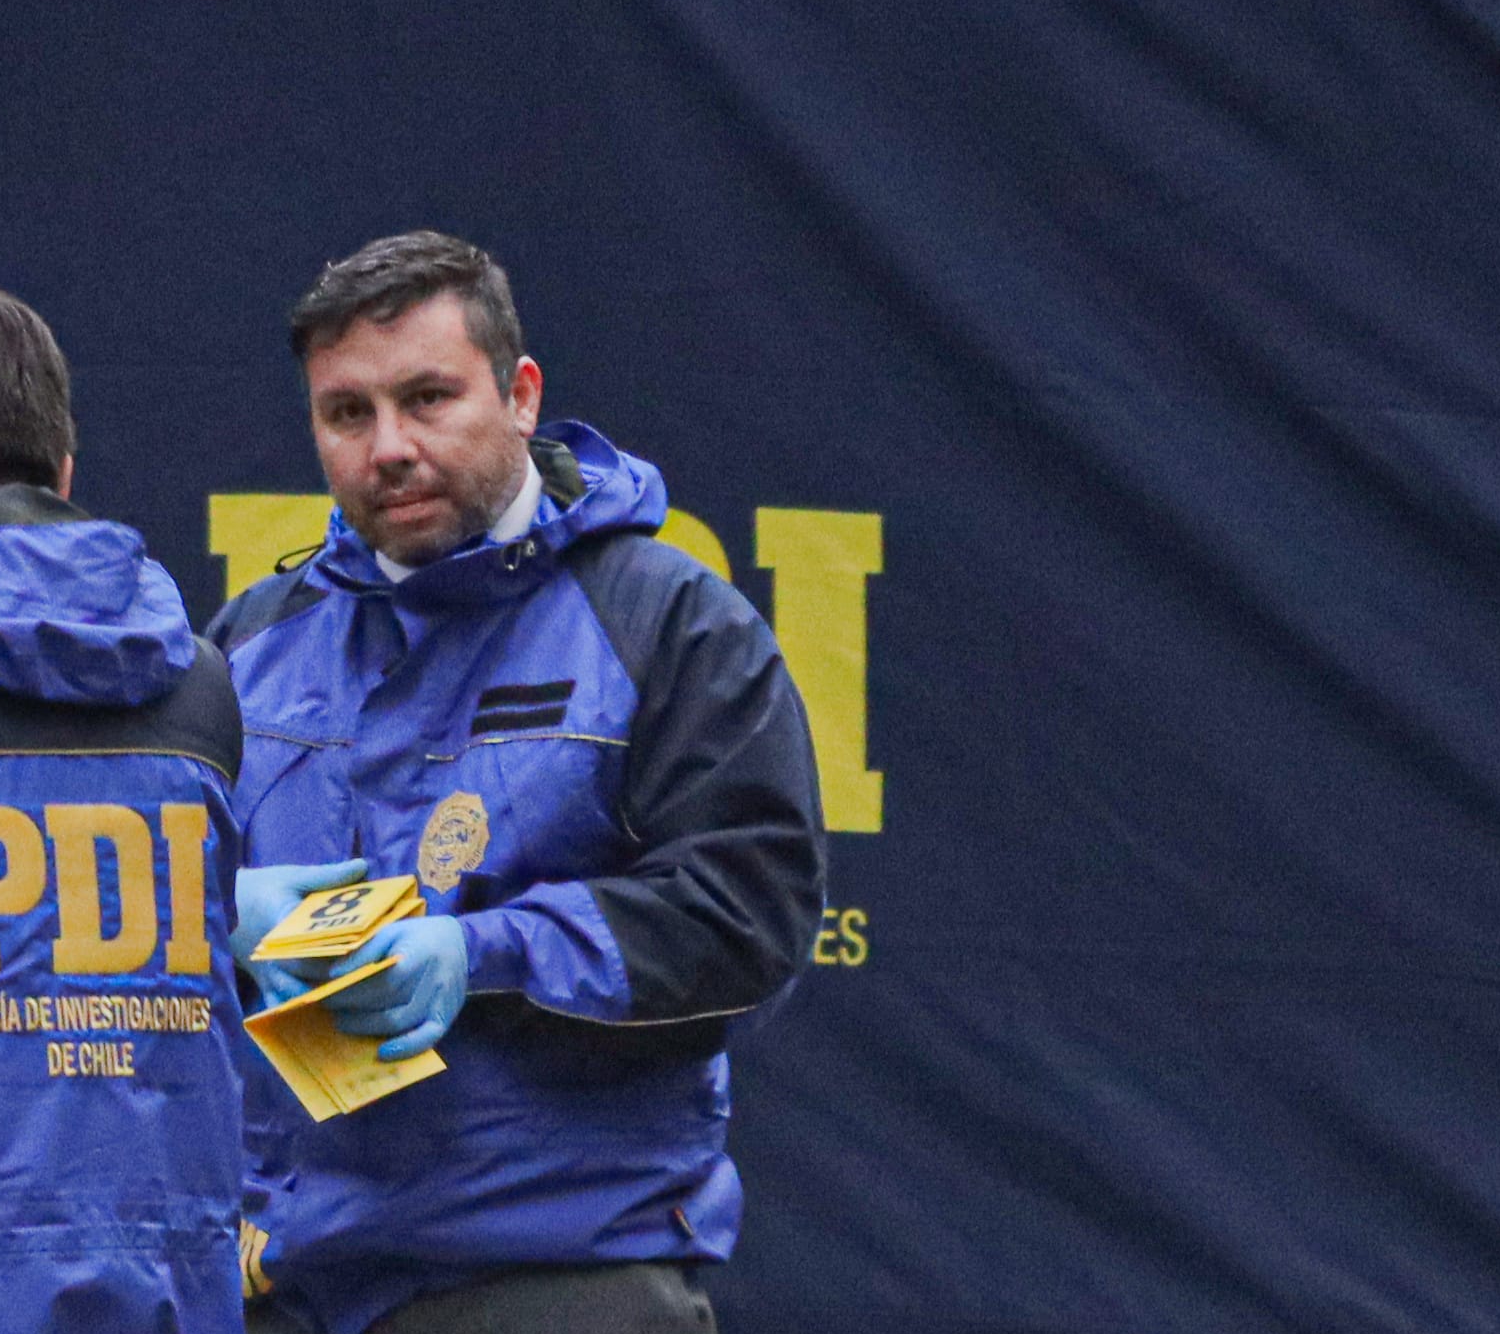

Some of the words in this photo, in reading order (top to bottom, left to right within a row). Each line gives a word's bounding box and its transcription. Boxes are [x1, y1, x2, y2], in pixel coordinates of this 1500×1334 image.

[310, 887, 373, 919] 8
[307, 915, 362, 931] PDI
[26, 996, 54, 1032] DE
[55, 995, 211, 1032] INVESTIGACIONES
[47, 1042, 76, 1077] DE
[78, 1042, 136, 1077] CHILE
